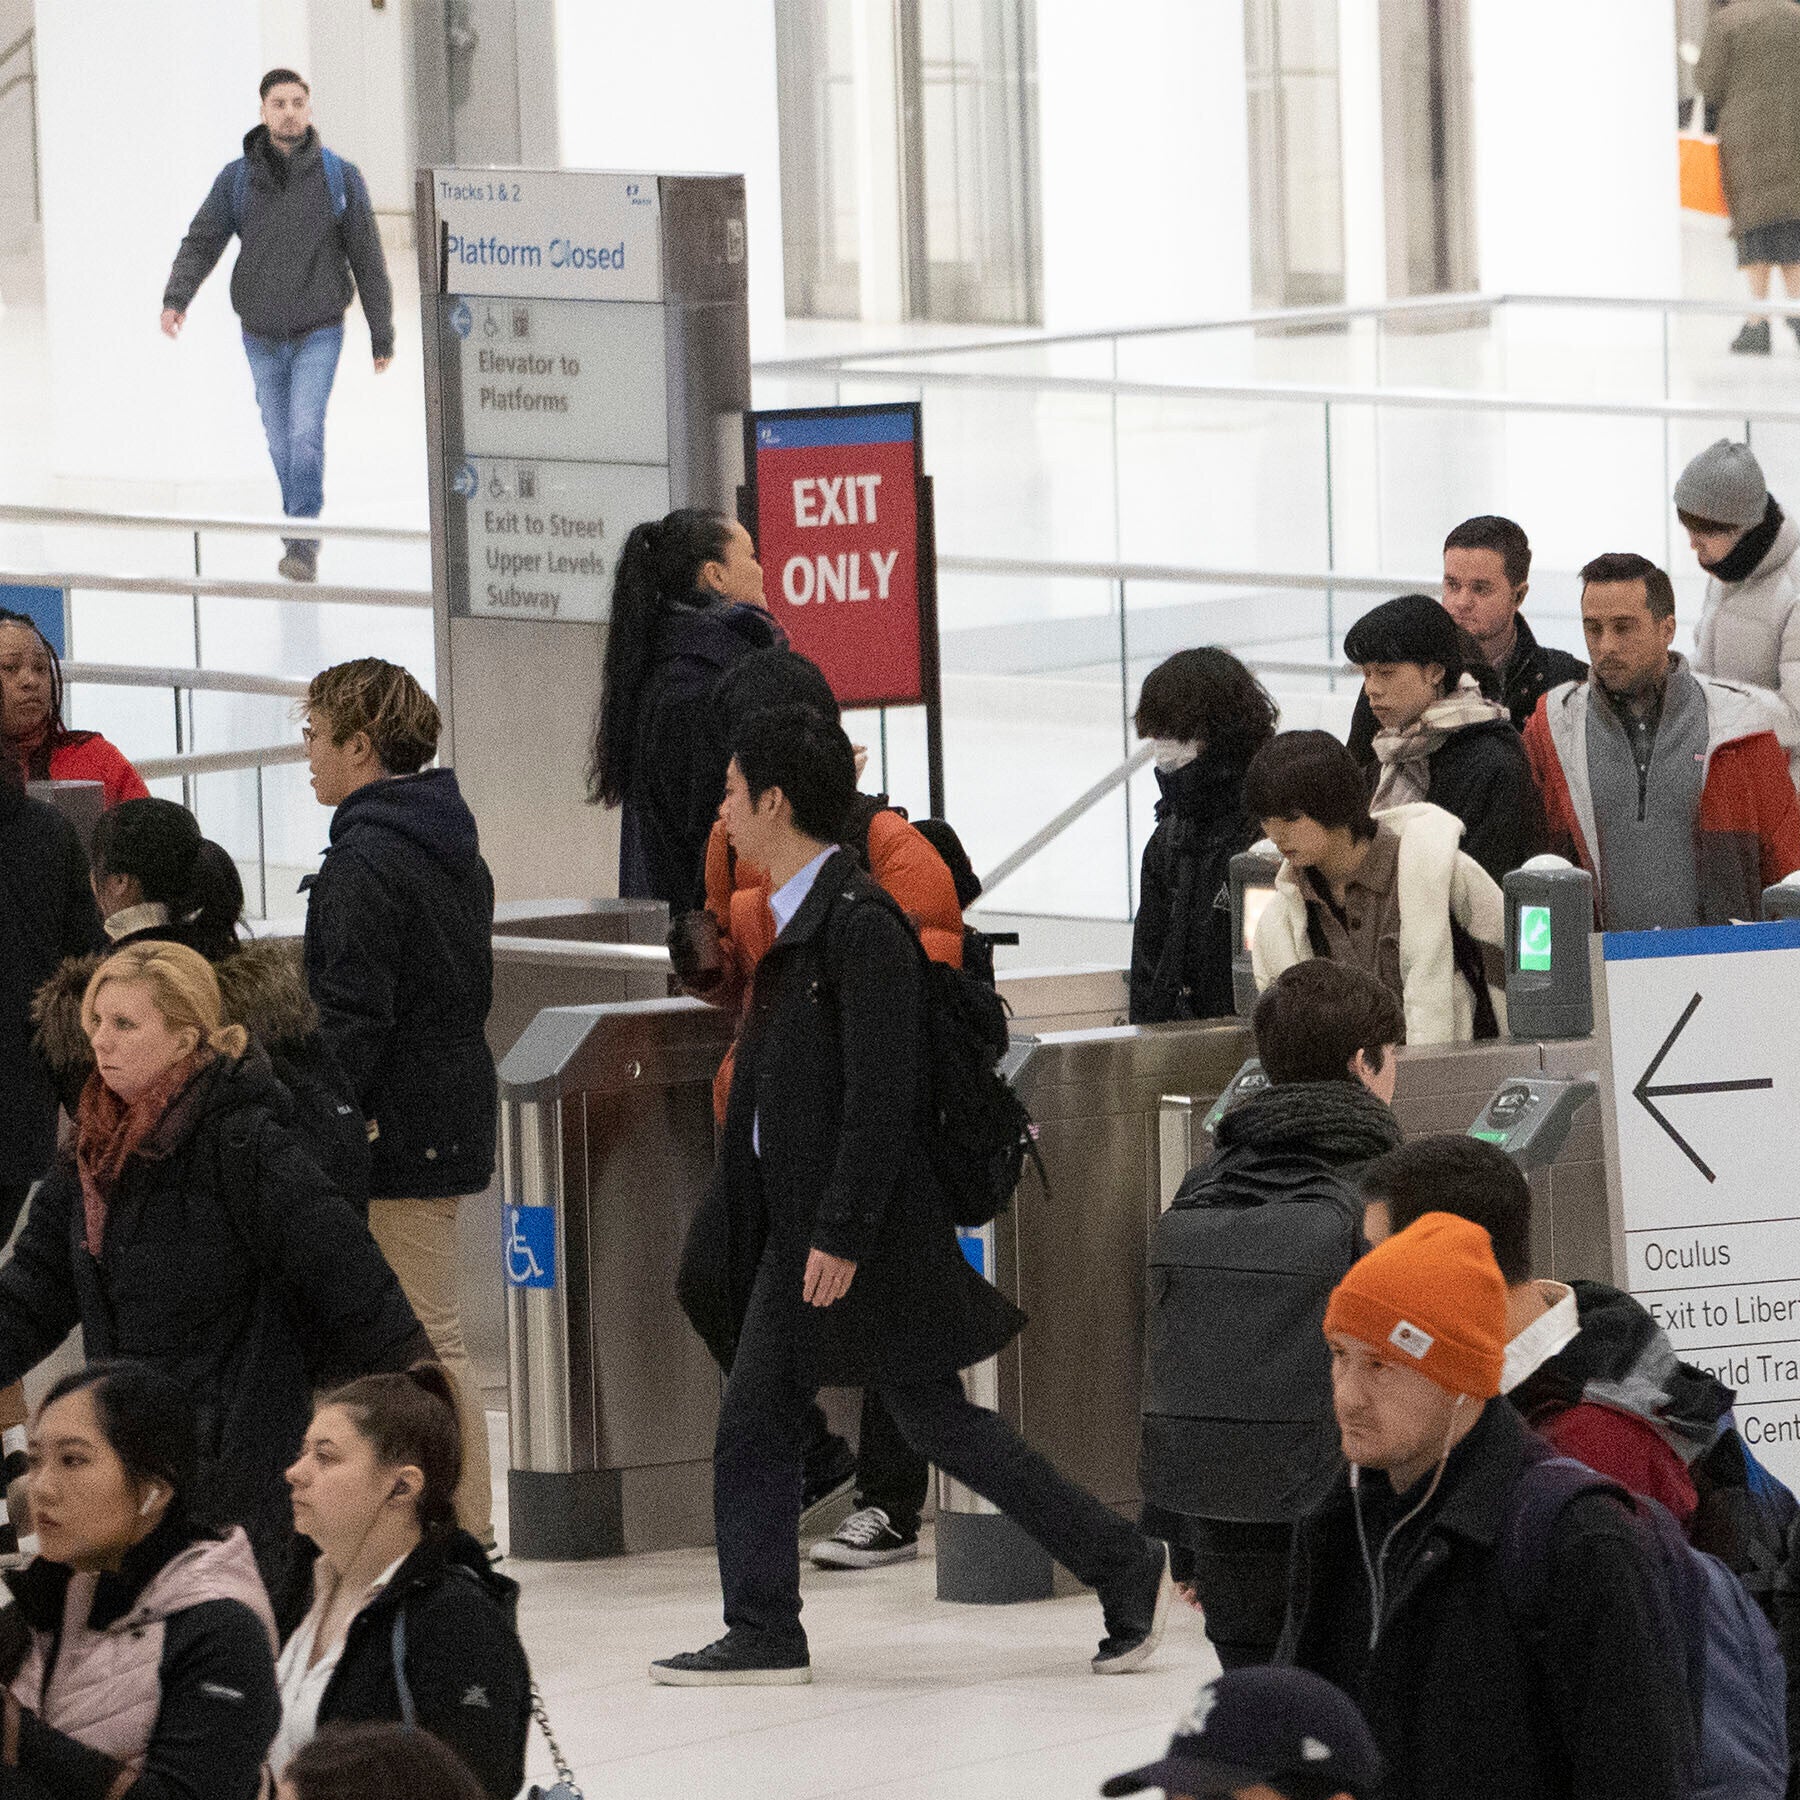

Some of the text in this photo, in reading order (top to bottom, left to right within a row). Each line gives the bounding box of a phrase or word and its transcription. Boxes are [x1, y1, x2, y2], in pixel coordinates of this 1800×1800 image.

[440, 182, 522, 202] Tracks 1 & 2
[448, 235, 625, 270] Platform Closed
[478, 350, 581, 377] Elevator to
[480, 386, 569, 413] Platforms
[793, 474, 882, 528] EXIT
[485, 510, 605, 539] Exit to Street
[486, 545, 604, 577] Upper Levels
[782, 550, 899, 607] ONLY
[486, 583, 561, 616] Subway
[1645, 1240, 1731, 1272] Oculus
[1650, 1302, 1697, 1331] Exit
[1703, 1300, 1728, 1328] to
